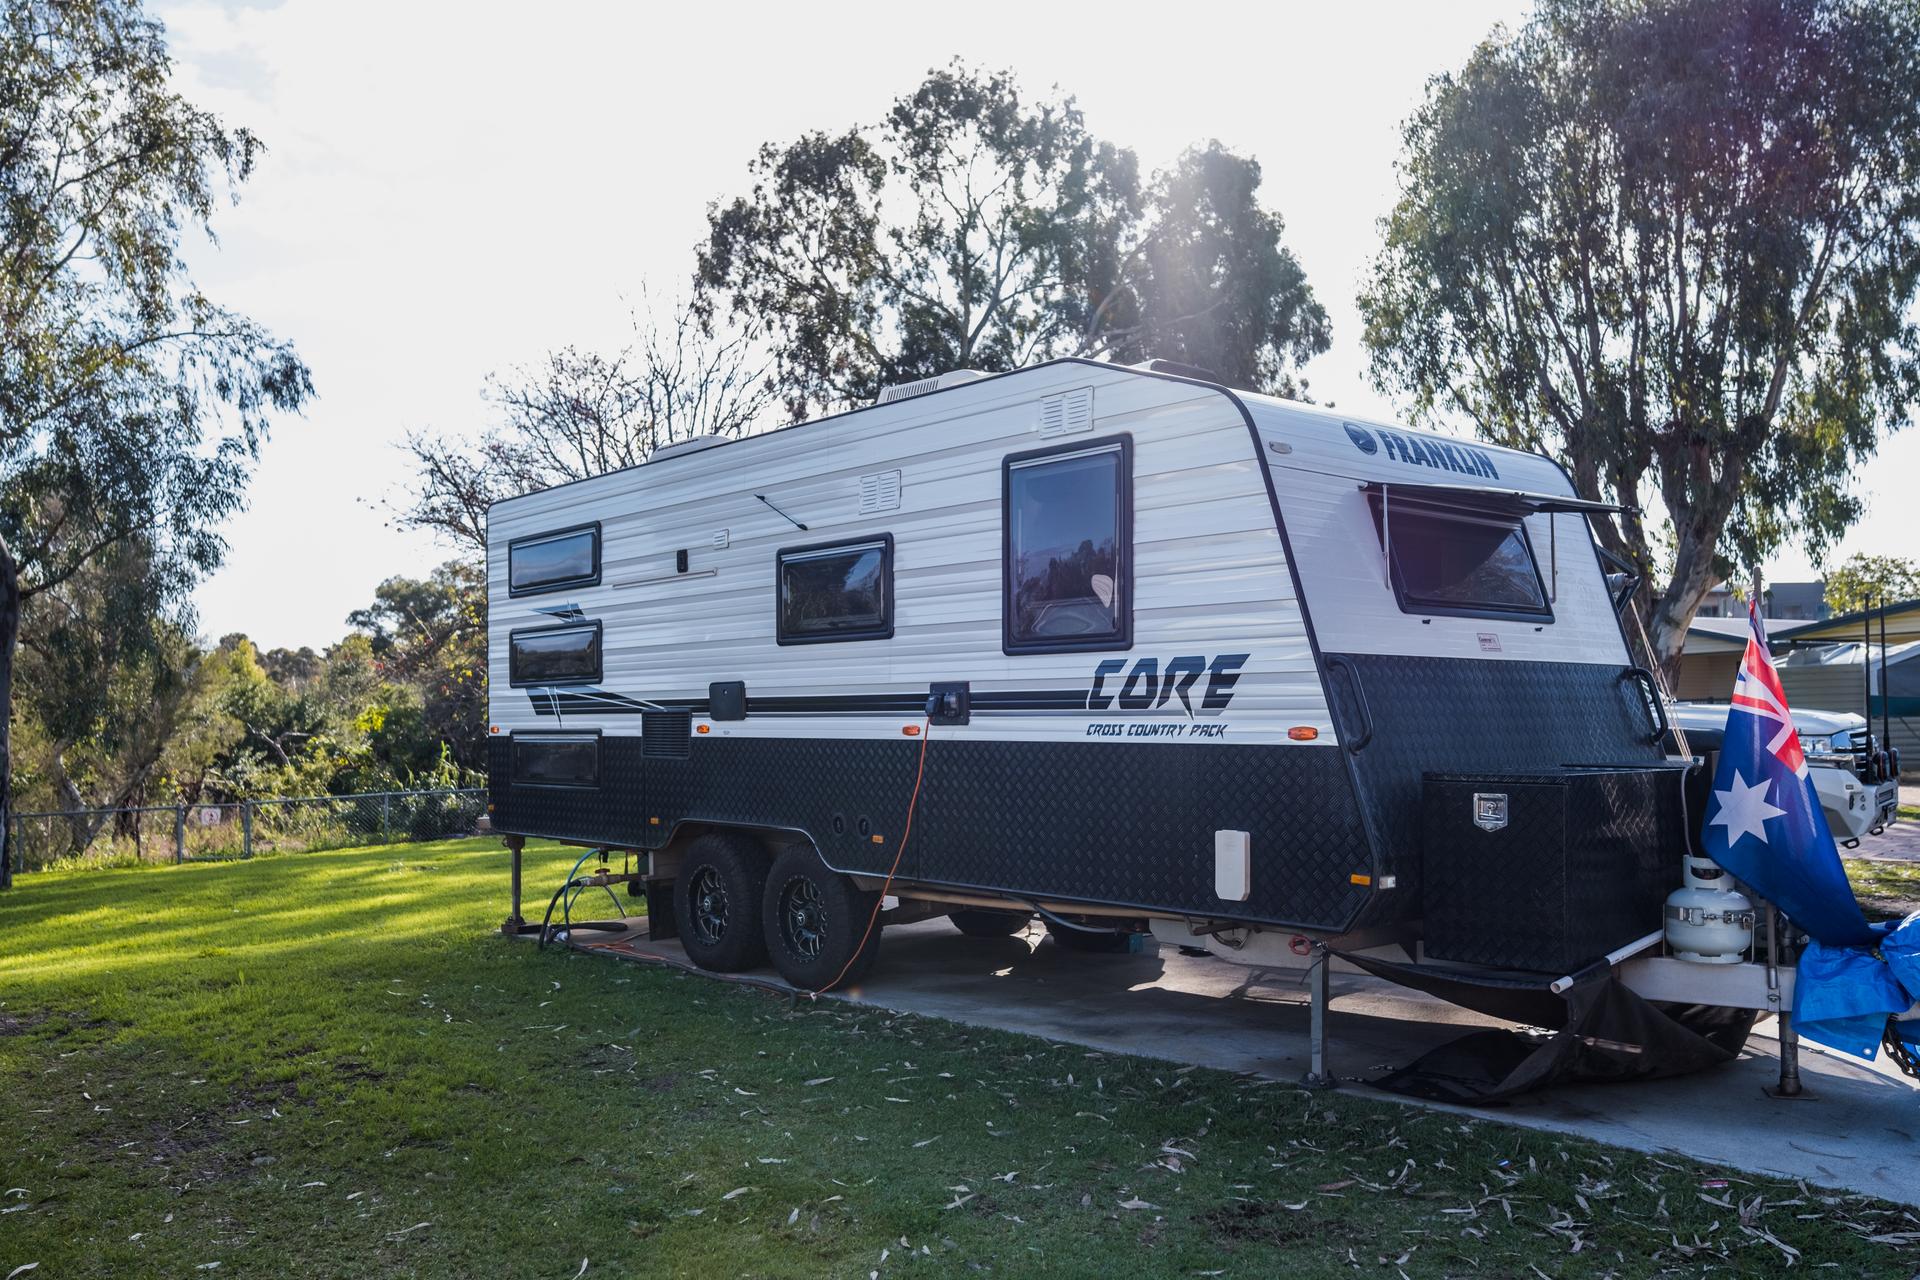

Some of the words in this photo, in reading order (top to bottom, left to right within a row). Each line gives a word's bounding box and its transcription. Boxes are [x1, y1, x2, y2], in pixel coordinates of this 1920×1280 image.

[1375, 429, 1500, 480] FRANKLIN
[1088, 653, 1251, 721] CORE
[1086, 723, 1125, 738] CROSS
[1127, 723, 1187, 739] COUNTRY
[1189, 724, 1228, 739] PACK
